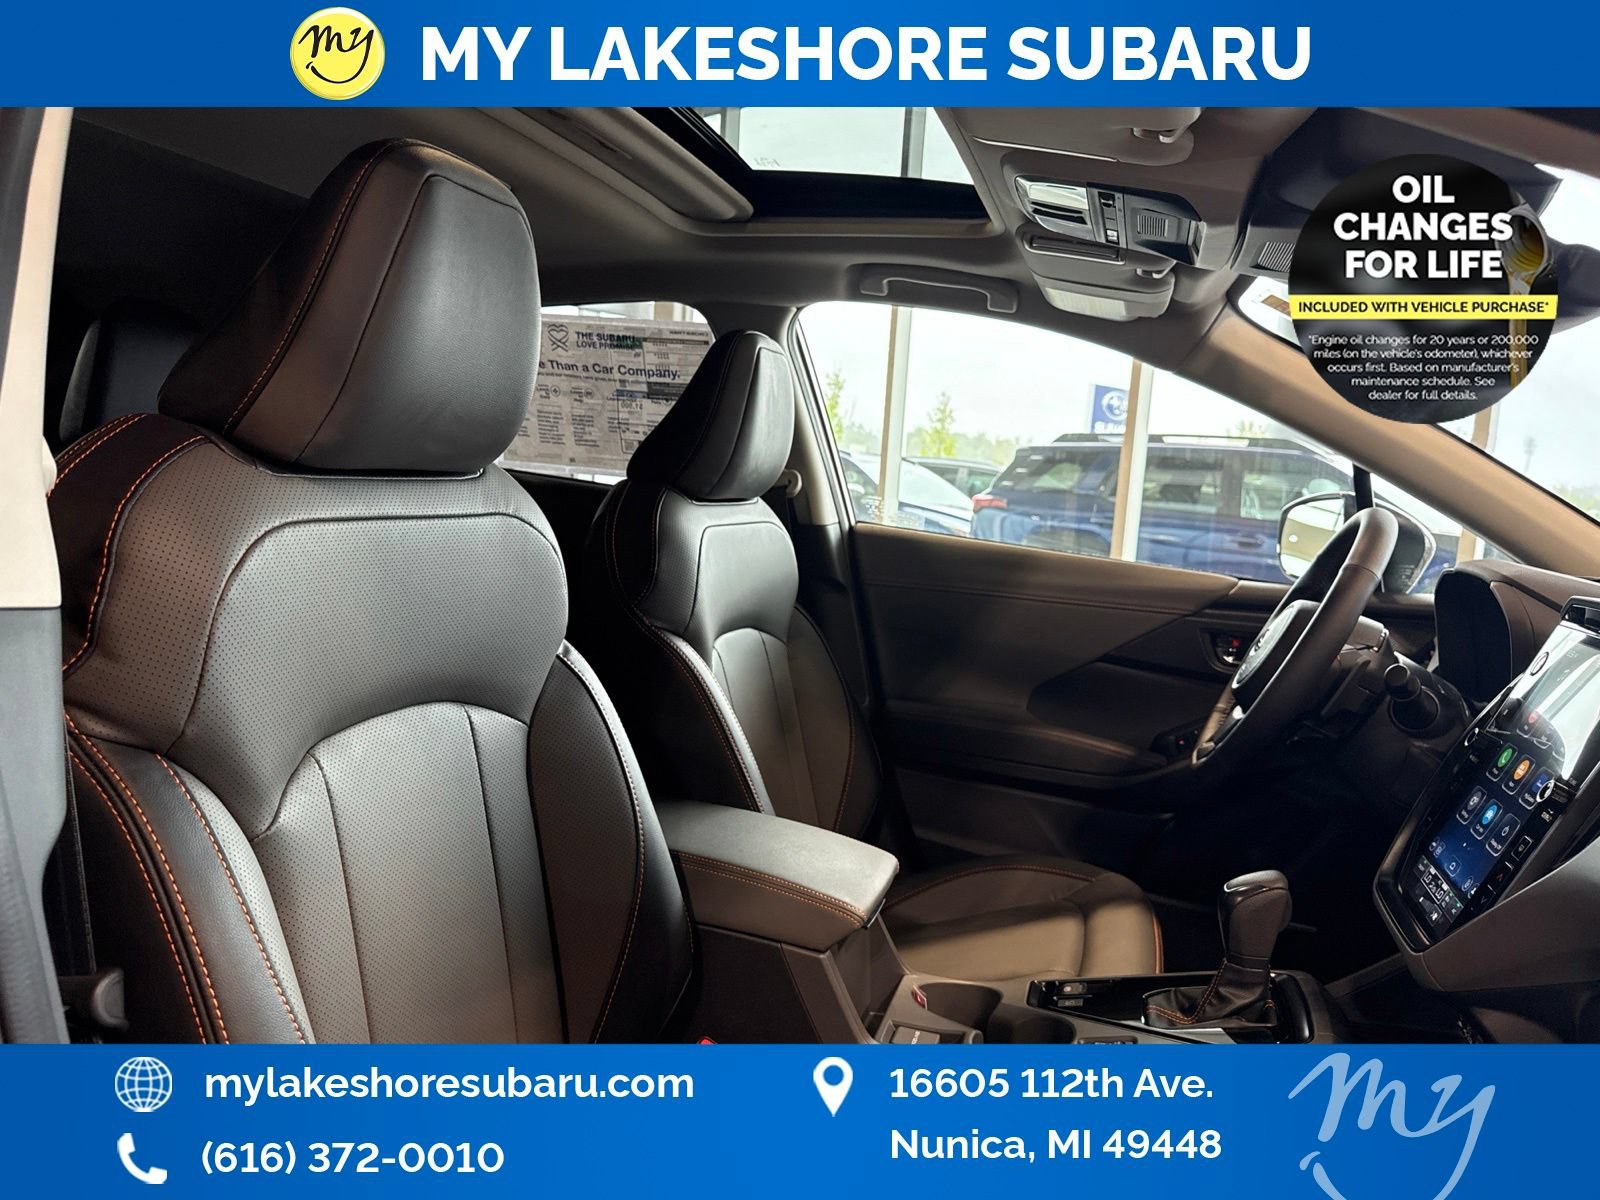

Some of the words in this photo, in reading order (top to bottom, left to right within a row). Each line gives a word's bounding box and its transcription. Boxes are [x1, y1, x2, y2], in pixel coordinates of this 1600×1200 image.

[575, 331, 594, 341] THE
[596, 333, 636, 343] SUBARU
[576, 340, 598, 349] LOVE
[547, 360, 579, 372] Than
[581, 363, 590, 372] a
[592, 363, 615, 375] Car
[617, 364, 681, 381] Company.
